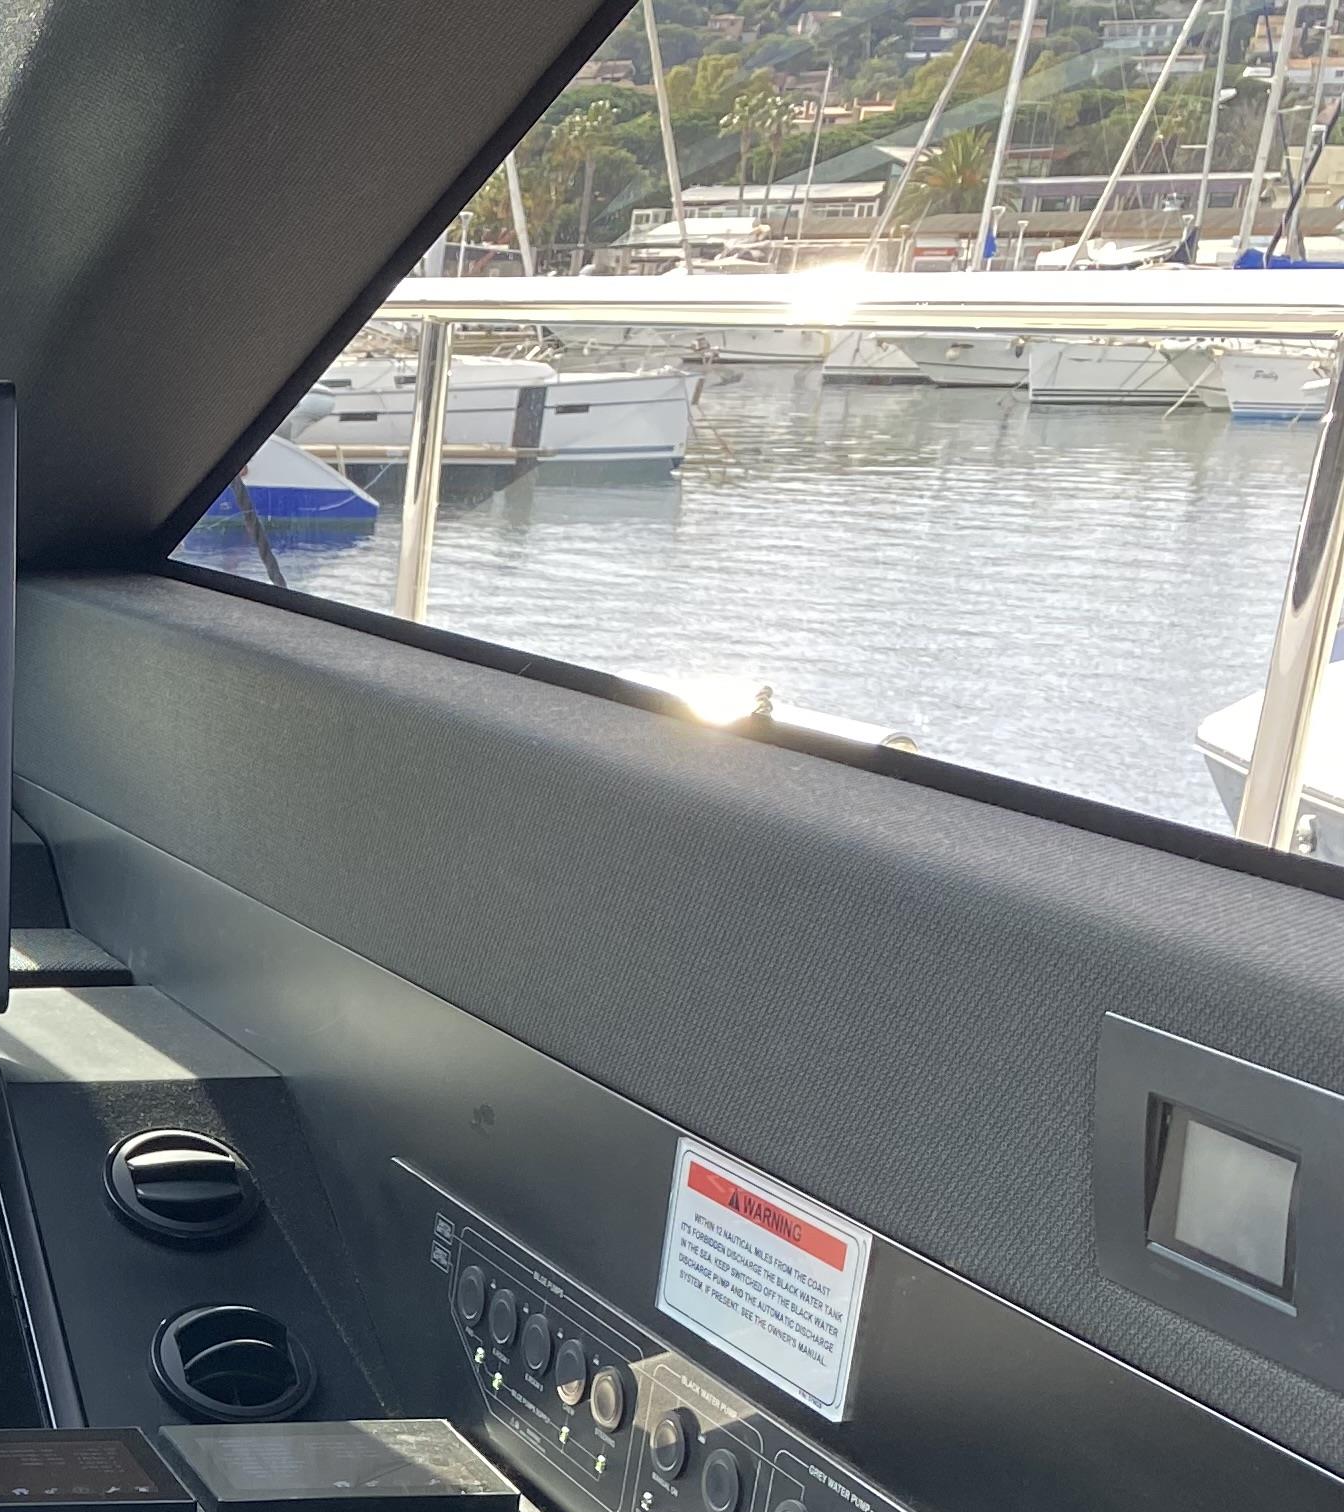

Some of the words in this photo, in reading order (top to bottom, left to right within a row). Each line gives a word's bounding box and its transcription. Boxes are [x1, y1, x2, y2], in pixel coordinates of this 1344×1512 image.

[743, 1194, 803, 1243] WARNING
[681, 1221, 692, 1235] IT'S
[692, 1226, 726, 1255] FORBIDDEN
[726, 1247, 762, 1276] DISCHARGE
[763, 1268, 776, 1284] THE
[776, 1276, 799, 1297] BLACK
[799, 1290, 824, 1311] WATER
[824, 1304, 844, 1323] TANK
[694, 1212, 715, 1232] WITHIN
[716, 1225, 724, 1237] 12
[723, 1229, 753, 1255] NAUTICAL
[754, 1246, 774, 1265] MILES
[774, 1255, 793, 1276] FROM
[794, 1268, 808, 1285] THE
[807, 1278, 831, 1297] COAST
[679, 1252, 712, 1279] DISCHARGE
[712, 1272, 730, 1289] PUMP
[730, 1284, 744, 1299] AND
[744, 1290, 758, 1306] THE
[757, 1300, 795, 1329] AUTOMATIC
[794, 1322, 834, 1353] DISCHARGE
[688, 1241, 699, 1256] THE
[714, 1256, 731, 1273] KEEP
[731, 1267, 763, 1293] SWITCHED
[763, 1286, 777, 1301] OFF
[777, 1293, 790, 1310] THE
[790, 1302, 813, 1322] BLACK
[814, 1316, 839, 1338] WATER
[741, 1307, 754, 1325] SEE
[754, 1314, 767, 1330] THE
[767, 1322, 797, 1351] OWNER'S
[680, 1375, 701, 1398] BLACK
[700, 1389, 722, 1409] WATER
[721, 1402, 738, 1419] PUMP
[808, 1464, 827, 1485] GREY
[827, 1478, 851, 1501] WATER
[850, 1493, 871, 1512] PUMP
